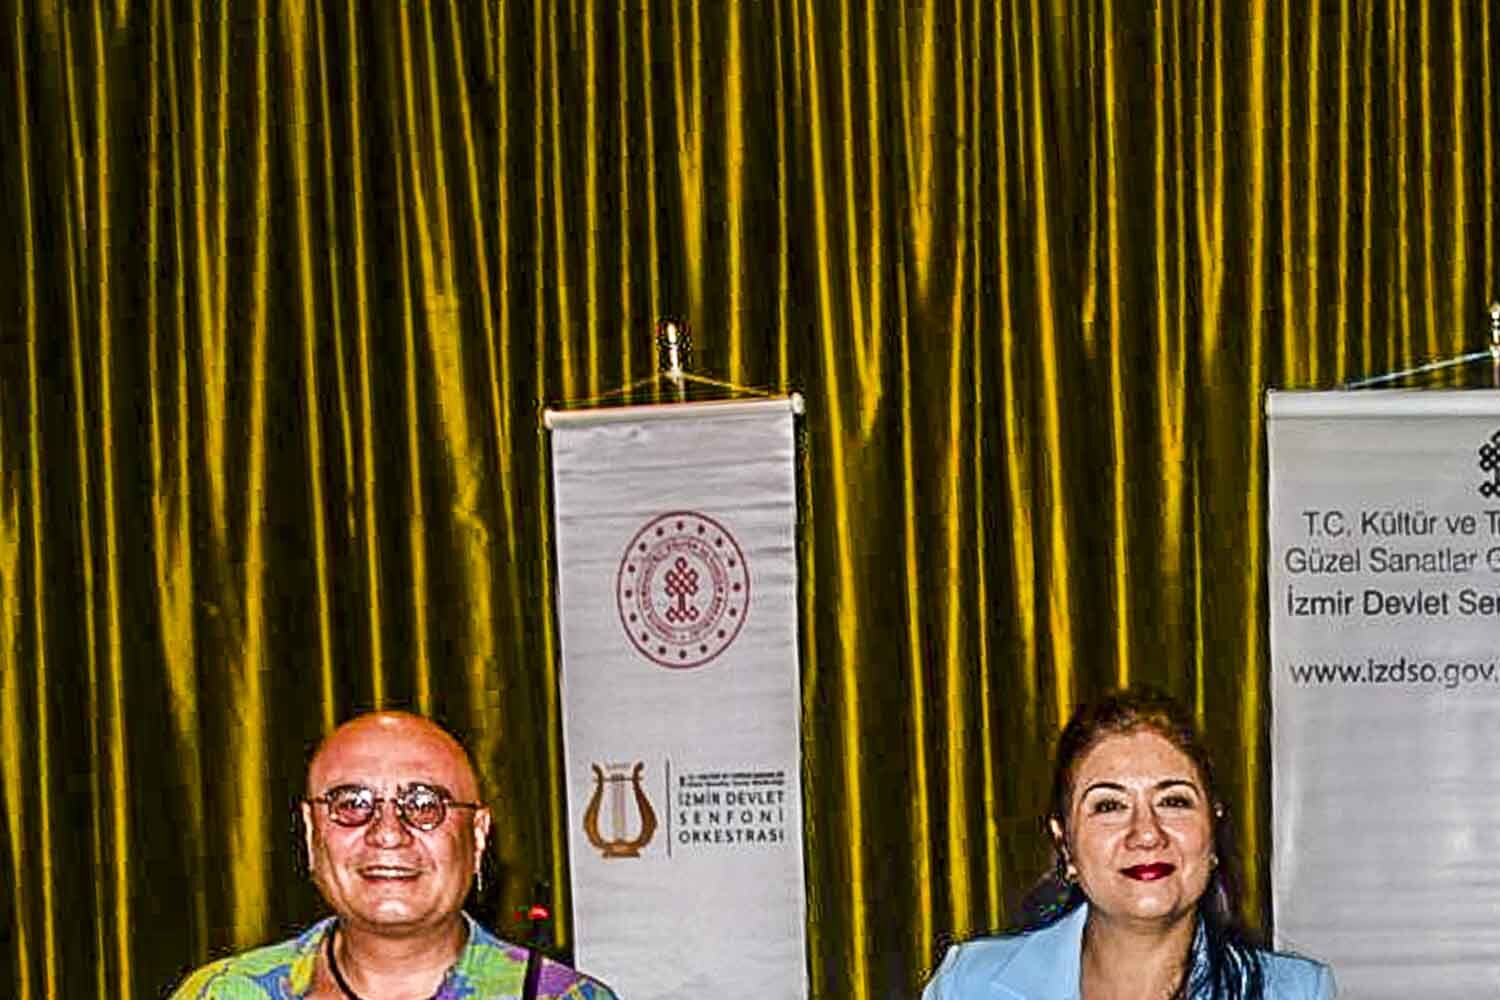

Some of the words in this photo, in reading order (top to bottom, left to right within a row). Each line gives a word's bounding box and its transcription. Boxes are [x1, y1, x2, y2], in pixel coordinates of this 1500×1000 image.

[1302, 511, 1352, 536] T.C.
[1362, 511, 1437, 535] Kültür
[1445, 514, 1476, 535] ve
[1285, 547, 1361, 573] Güzel
[1368, 547, 1478, 573] Sanatlar
[1287, 584, 1354, 616] İzmir
[1363, 588, 1448, 616] Devlet
[725, 789, 784, 806] DEVLET
